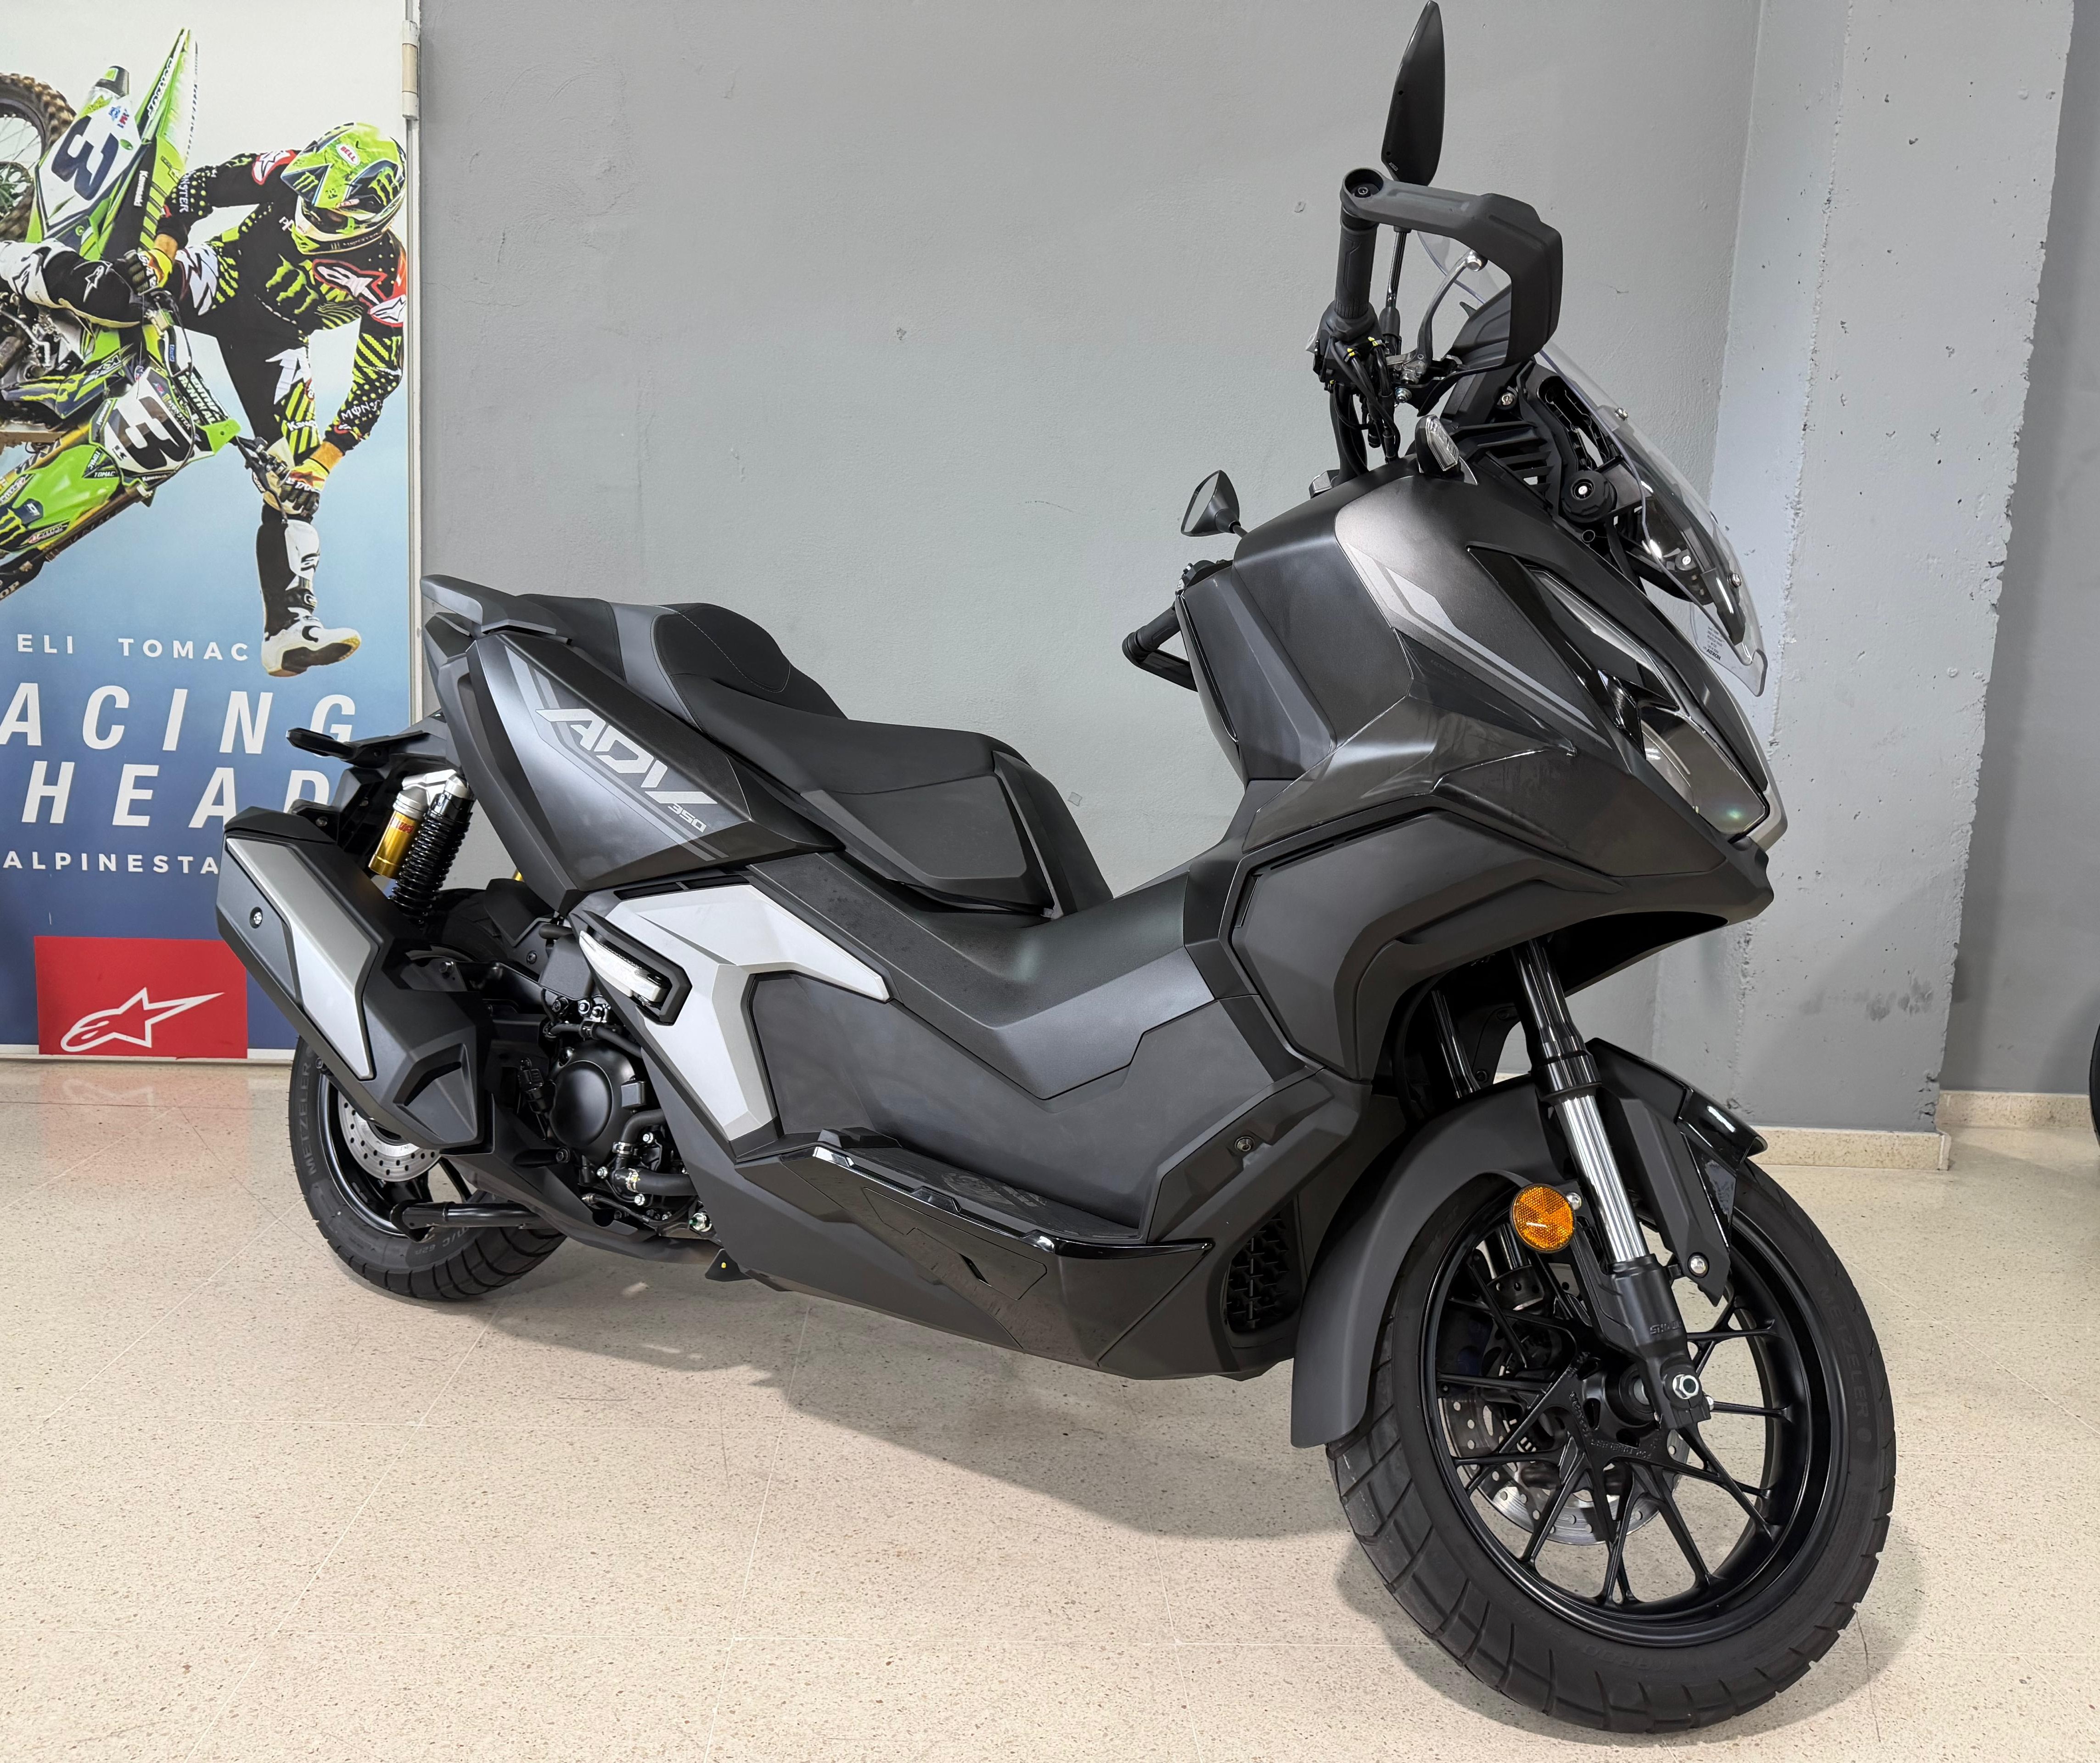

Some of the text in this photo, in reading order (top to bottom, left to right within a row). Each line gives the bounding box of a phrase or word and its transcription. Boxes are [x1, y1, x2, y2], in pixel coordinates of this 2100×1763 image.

[340, 146, 356, 163] BELL
[178, 375, 217, 425] RENTHAL
[107, 396, 191, 470] 3
[17, 634, 248, 661] ELI TOMAC
[535, 708, 718, 804] ADV
[22, 760, 330, 831] HEAD
[668, 803, 707, 833] 350
[3, 851, 219, 874] ALPINESTA
[298, 1061, 317, 1176] METZELER
[1817, 1285, 1870, 1417] METZELER
